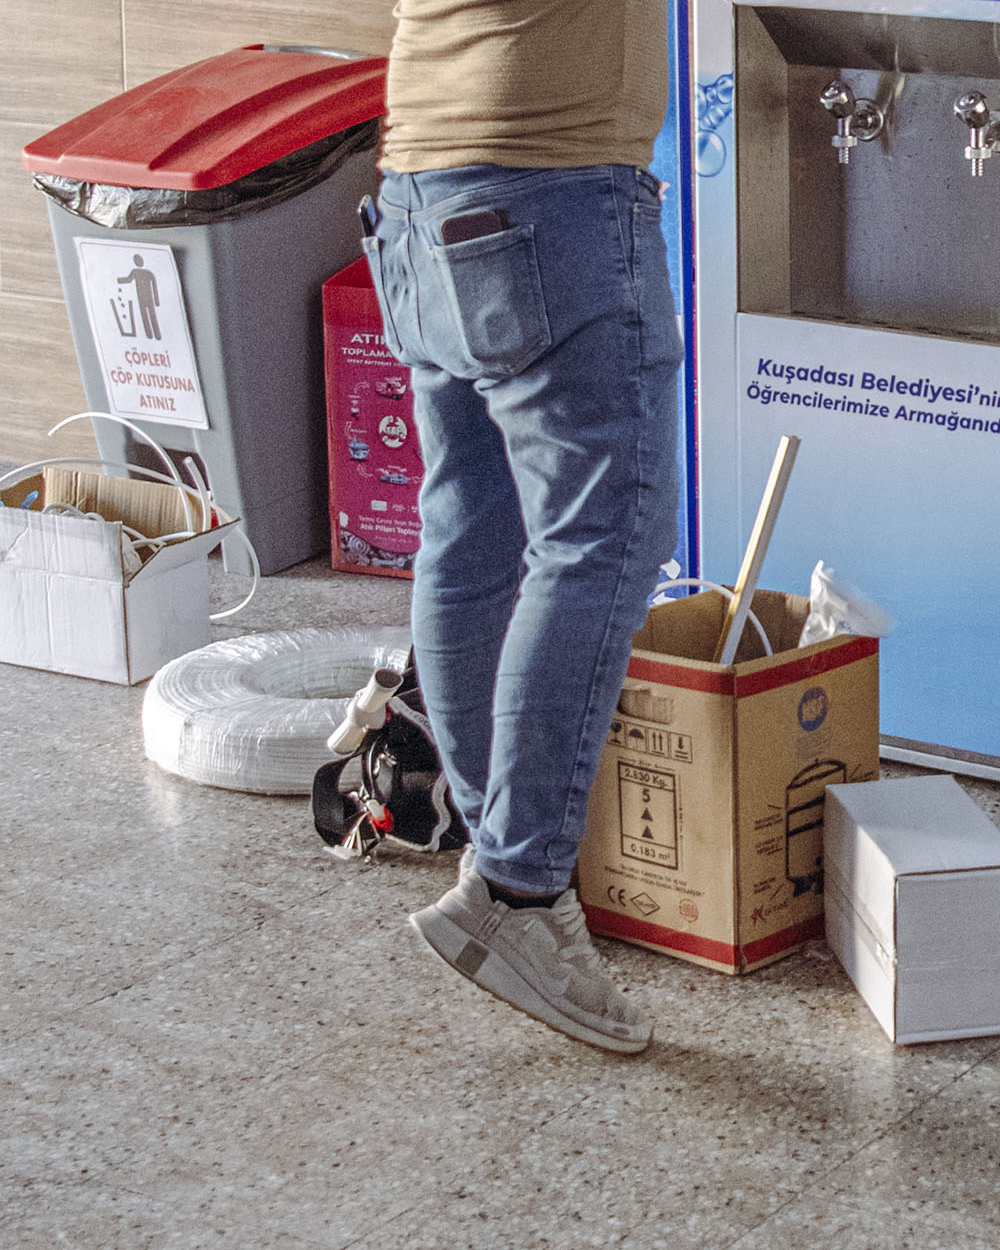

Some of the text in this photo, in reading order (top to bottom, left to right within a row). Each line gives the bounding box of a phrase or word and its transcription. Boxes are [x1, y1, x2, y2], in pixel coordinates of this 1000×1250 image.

[124, 346, 172, 368] ÇÖPLERİ
[110, 365, 196, 393] ÇÖP KUTUSUNA
[756, 358, 855, 388] Kuşadası
[139, 393, 177, 412] ATINIZ
[746, 380, 891, 418] Öğrencilerimize
[642, 788, 651, 803] 5
